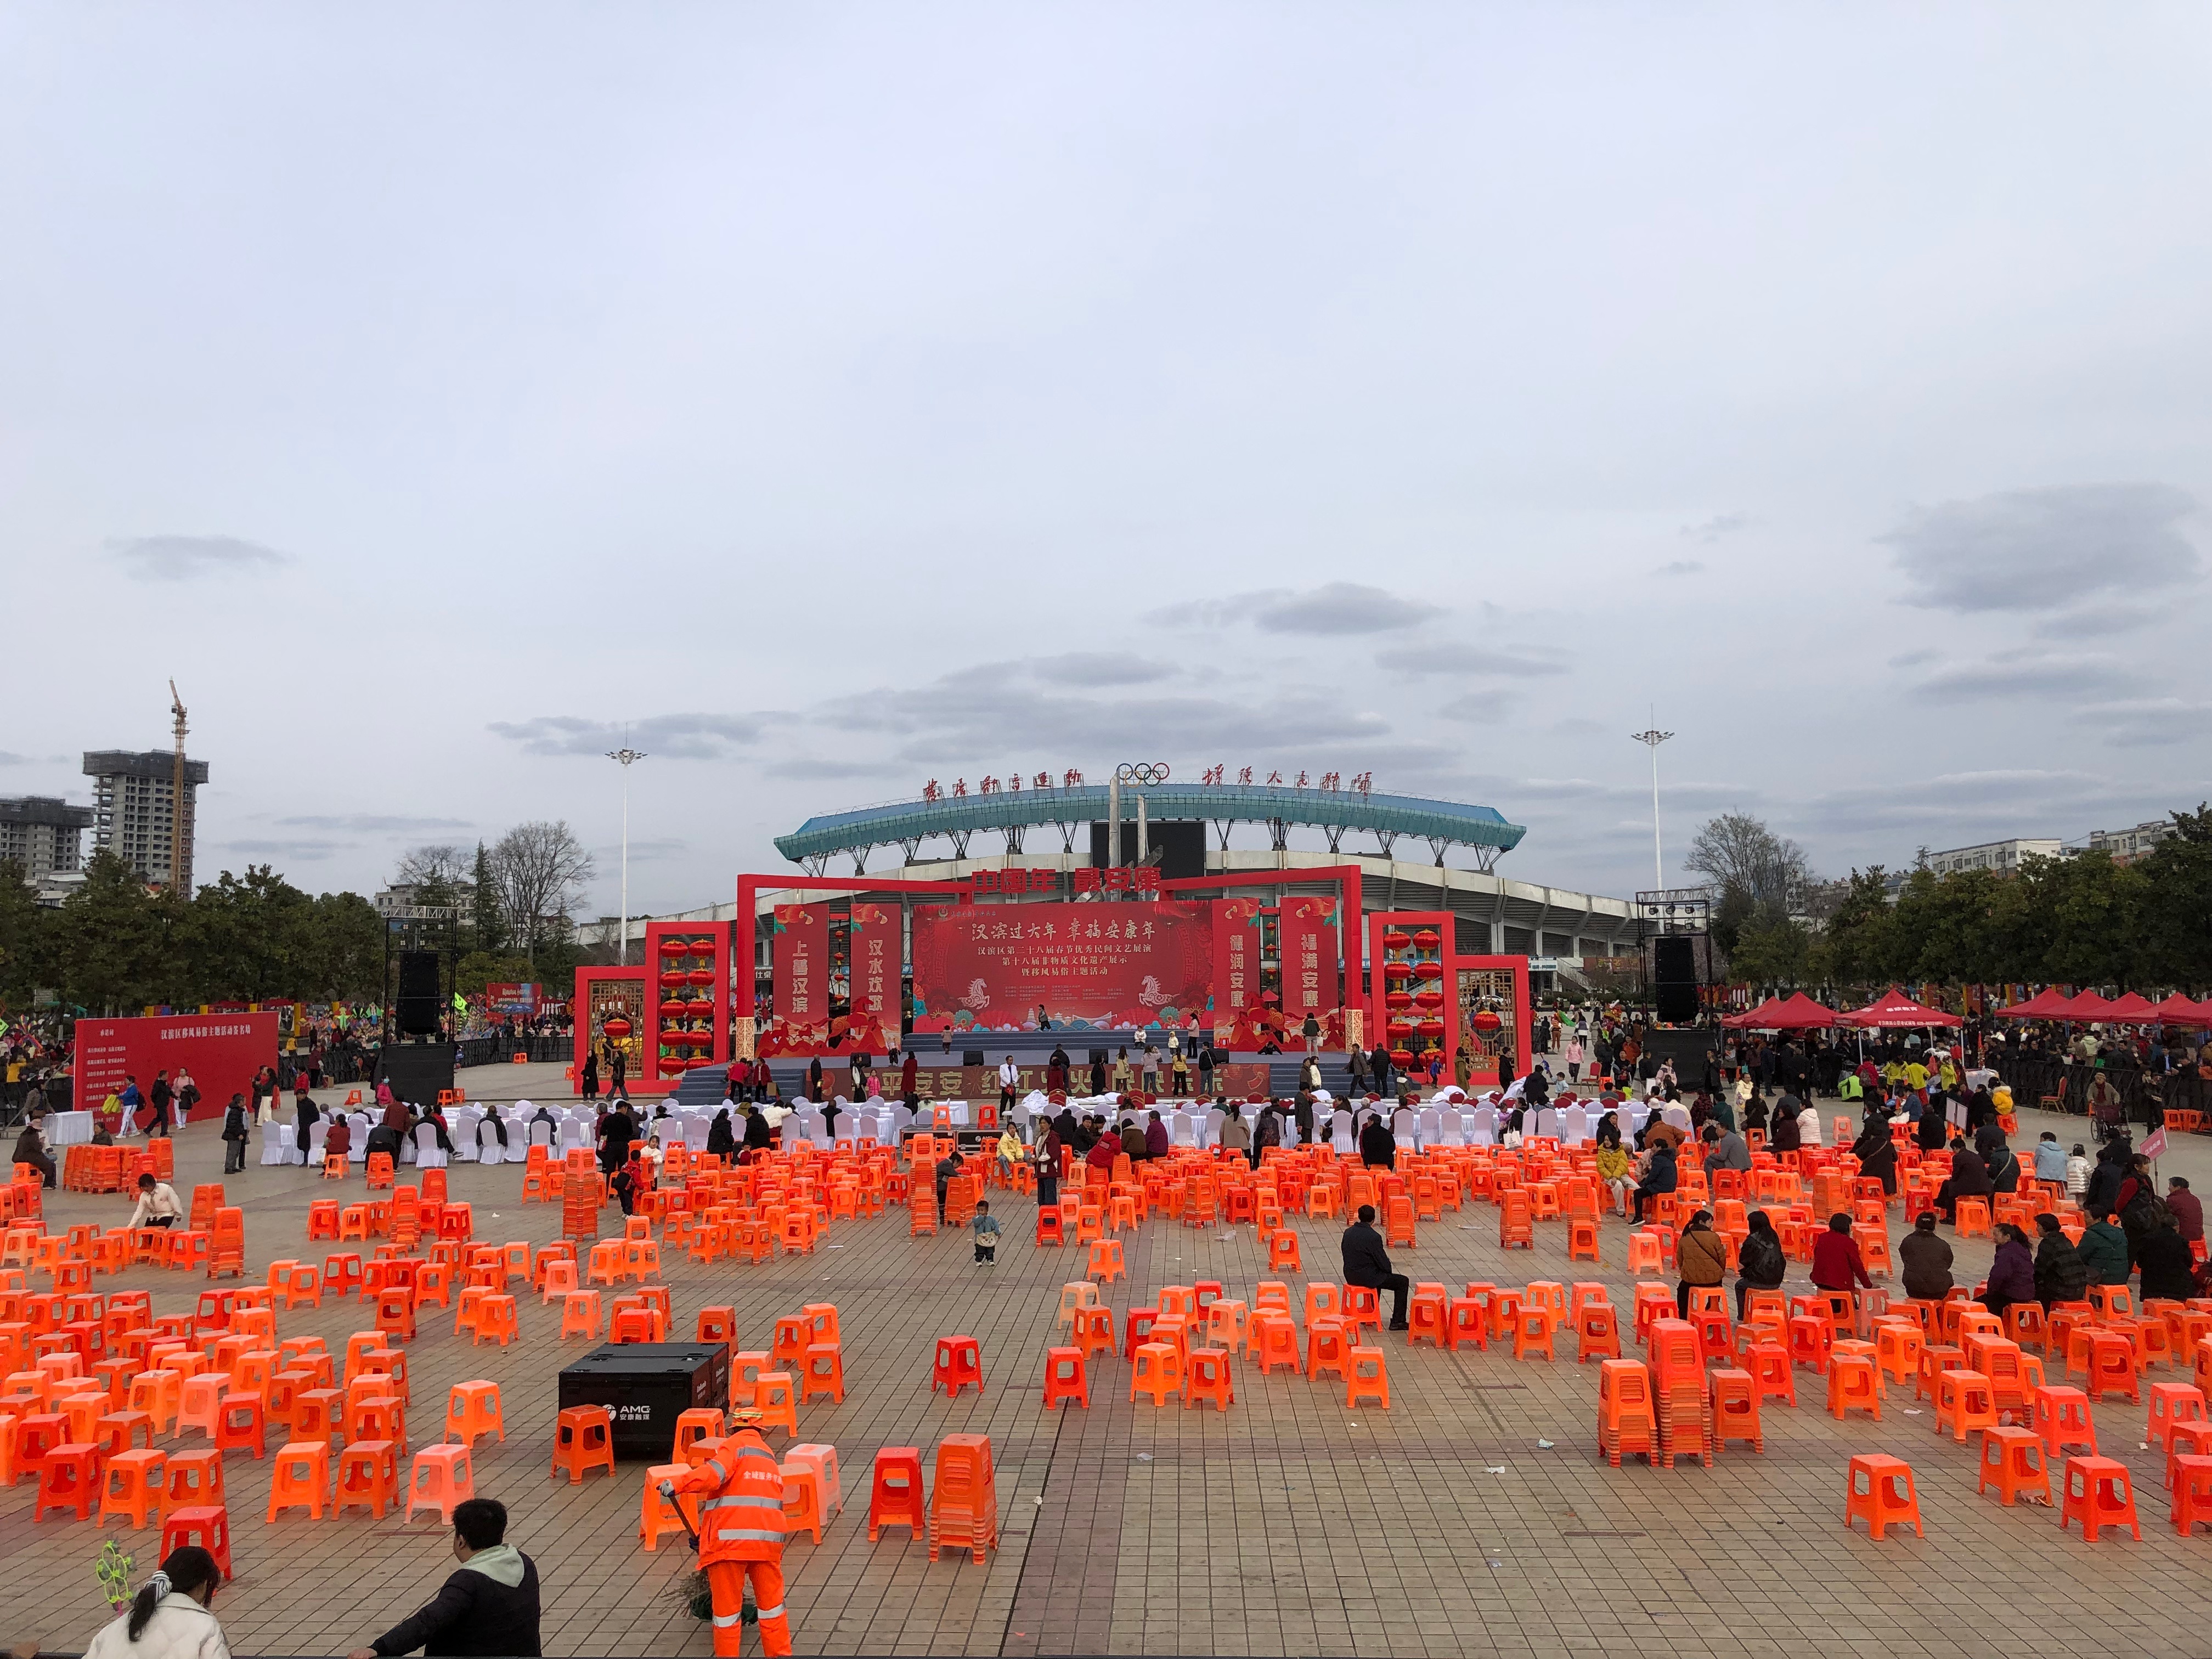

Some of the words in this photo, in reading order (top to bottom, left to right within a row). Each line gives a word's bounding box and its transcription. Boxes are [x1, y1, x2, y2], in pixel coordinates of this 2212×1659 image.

[972, 868, 1056, 894] 中国年
[1074, 867, 1161, 893] 最安康
[971, 922, 1057, 941] 汉滨过大年
[1066, 918, 1155, 941] 幸福安康年
[978, 944, 1152, 955] 汉滨区第二十八届春节优秀民间文艺展演
[1002, 955, 1127, 966] 第十八届非物质文化遗产展示
[868, 940, 883, 1011] 汉水欢歌
[1022, 966, 1108, 977] 暨移风易俗主题活动
[1230, 934, 1244, 1007] 德润安康
[1301, 934, 1318, 1007] 福满安康
[161, 1024, 251, 1040] 汉滨区移风易俗主题活动签名墙
[620, 1405, 651, 1413] AMG
